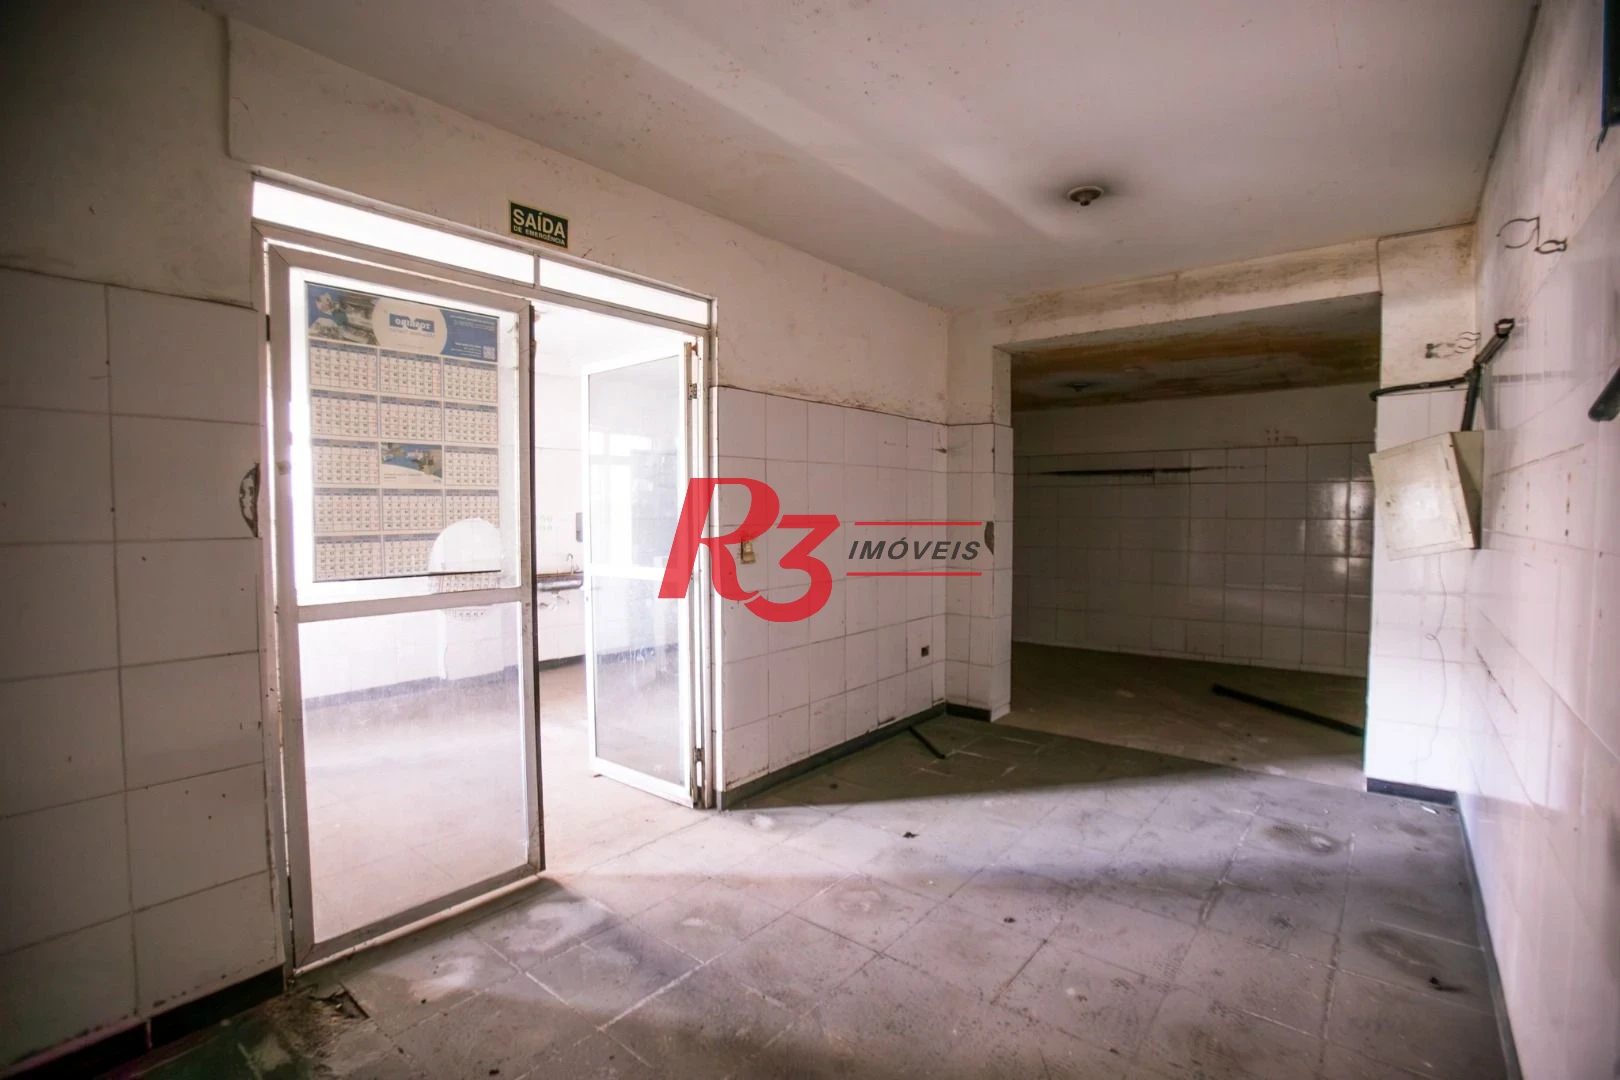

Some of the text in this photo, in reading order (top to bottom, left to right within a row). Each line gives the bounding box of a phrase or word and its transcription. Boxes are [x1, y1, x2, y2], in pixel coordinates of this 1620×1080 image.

[513, 208, 566, 239] SAÍDA
[513, 225, 565, 245] DE EMERGÊNCIA
